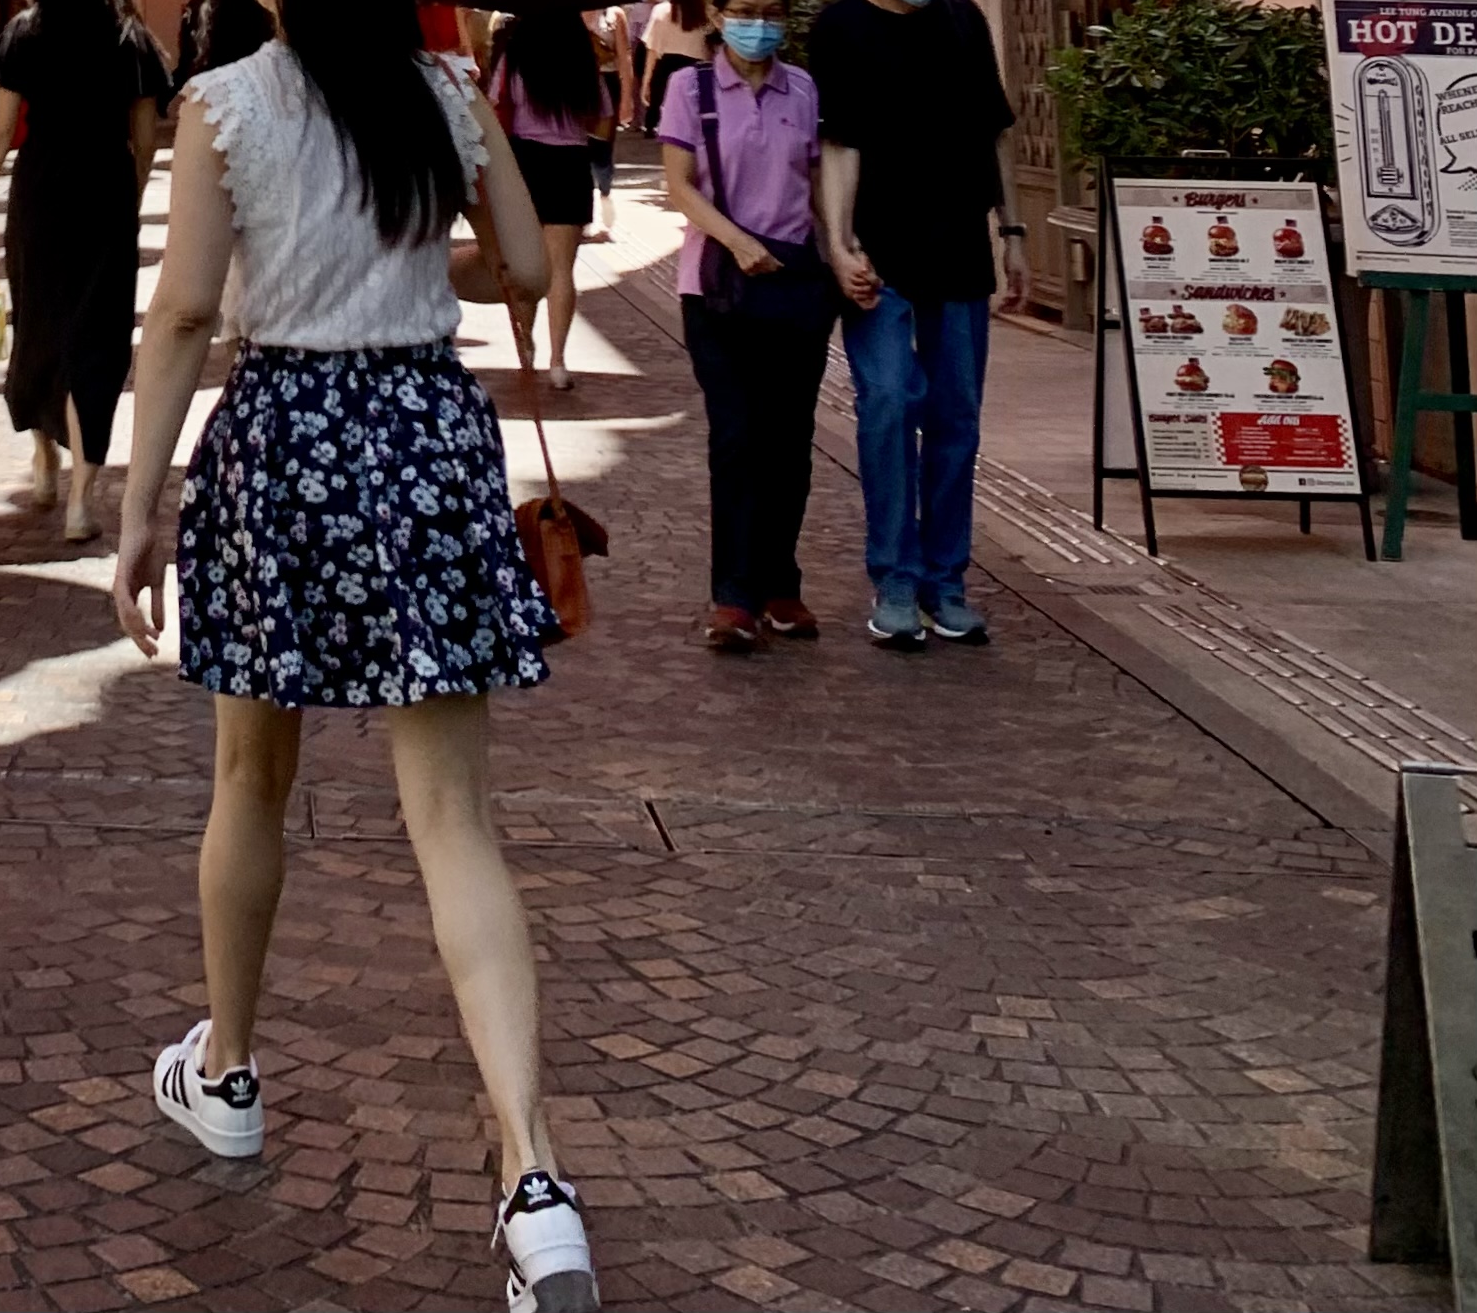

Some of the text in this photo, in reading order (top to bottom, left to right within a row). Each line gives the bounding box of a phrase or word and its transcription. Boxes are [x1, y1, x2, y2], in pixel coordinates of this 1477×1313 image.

[1398, 7, 1427, 17] TUNG
[1428, 9, 1469, 17] AVENUE
[1348, 19, 1417, 45] HOT
[1440, 134, 1458, 145] ALL
